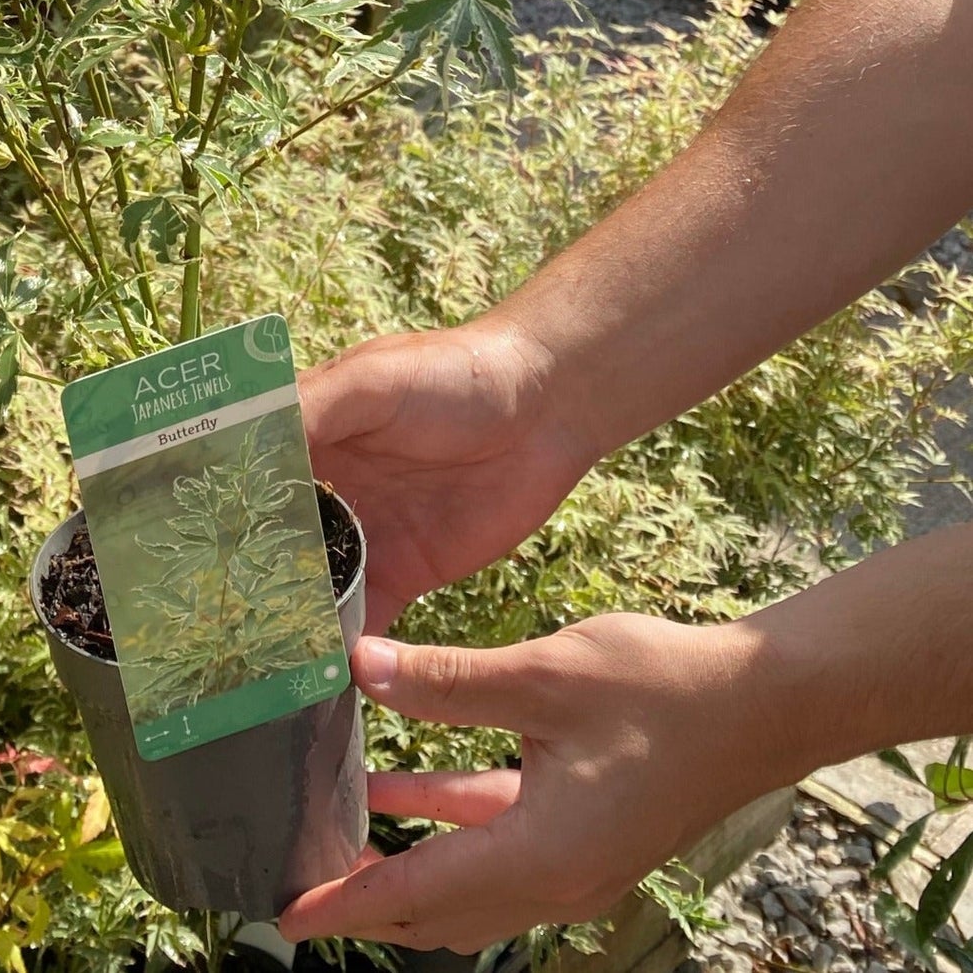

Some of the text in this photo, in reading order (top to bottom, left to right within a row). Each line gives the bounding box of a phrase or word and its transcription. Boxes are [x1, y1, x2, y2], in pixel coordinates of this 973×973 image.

[131, 373, 232, 425] JAPANESE JEWELS
[134, 352, 222, 401] ACER
[157, 418, 218, 446] Butterfly
